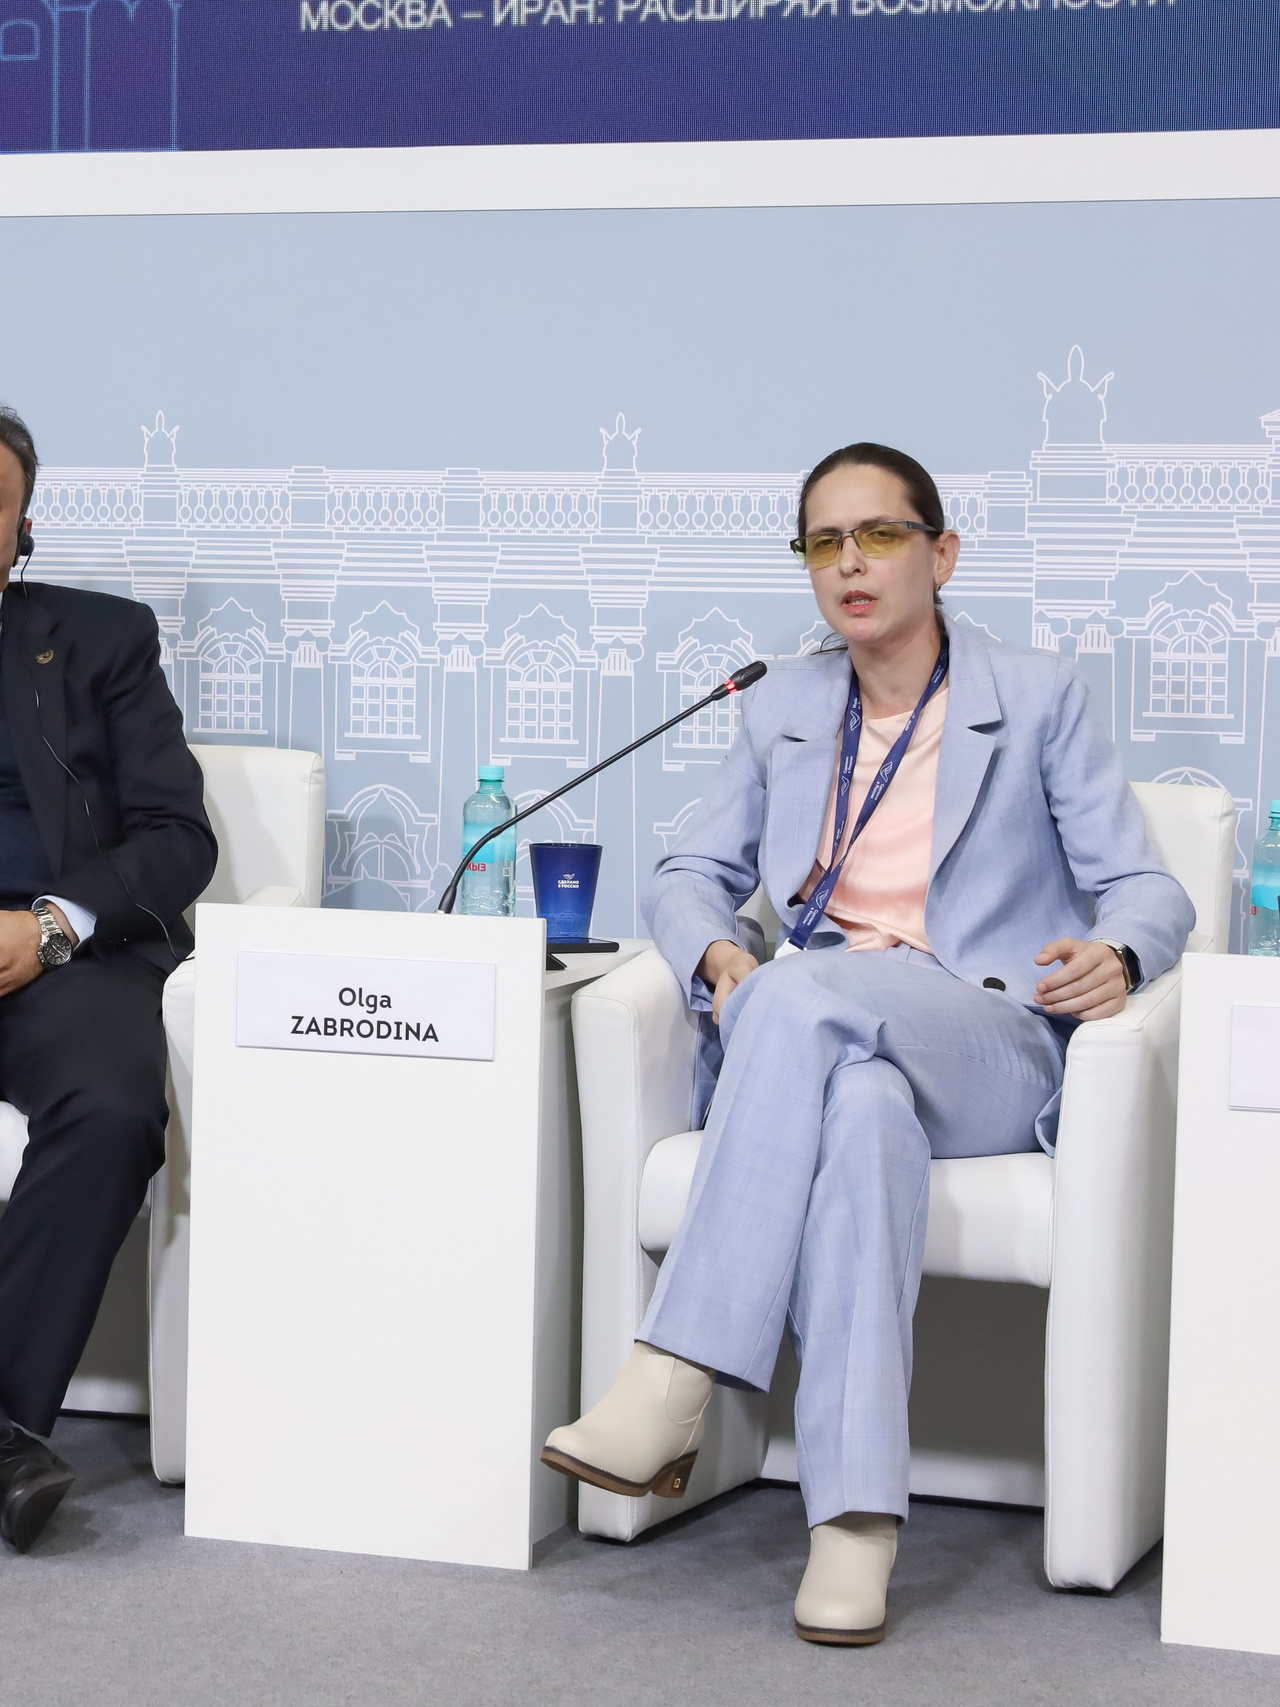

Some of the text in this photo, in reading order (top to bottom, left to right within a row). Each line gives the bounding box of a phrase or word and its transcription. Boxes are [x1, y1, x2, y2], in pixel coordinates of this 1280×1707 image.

[300, 0, 454, 31] МОСКВА
[493, 0, 605, 27] ИРАН:
[338, 987, 392, 1014] Olga
[290, 1015, 440, 1042] ZABRODINA
